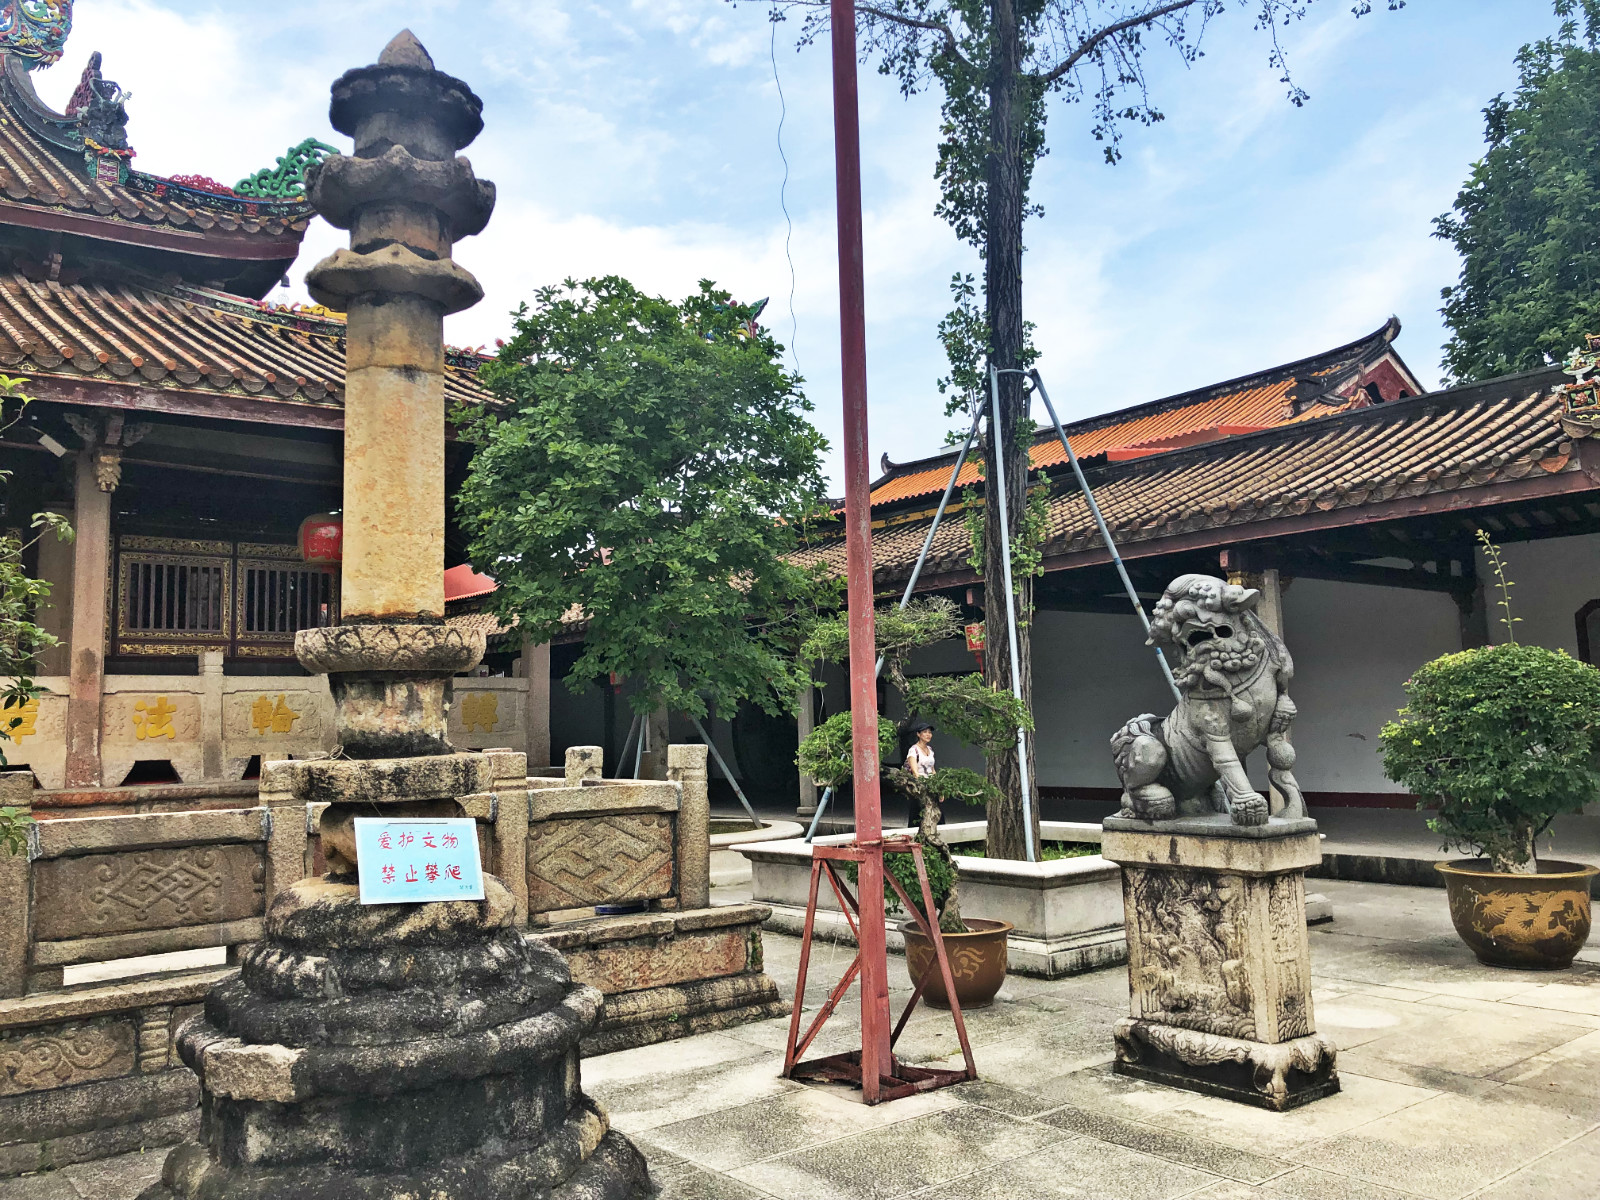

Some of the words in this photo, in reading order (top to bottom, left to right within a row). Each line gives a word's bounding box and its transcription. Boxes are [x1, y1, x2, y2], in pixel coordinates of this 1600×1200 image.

[132, 696, 177, 740] 法
[252, 693, 300, 735] 輪
[377, 831, 459, 850] 爱护文物
[381, 862, 462, 885] 禁止攀爬
